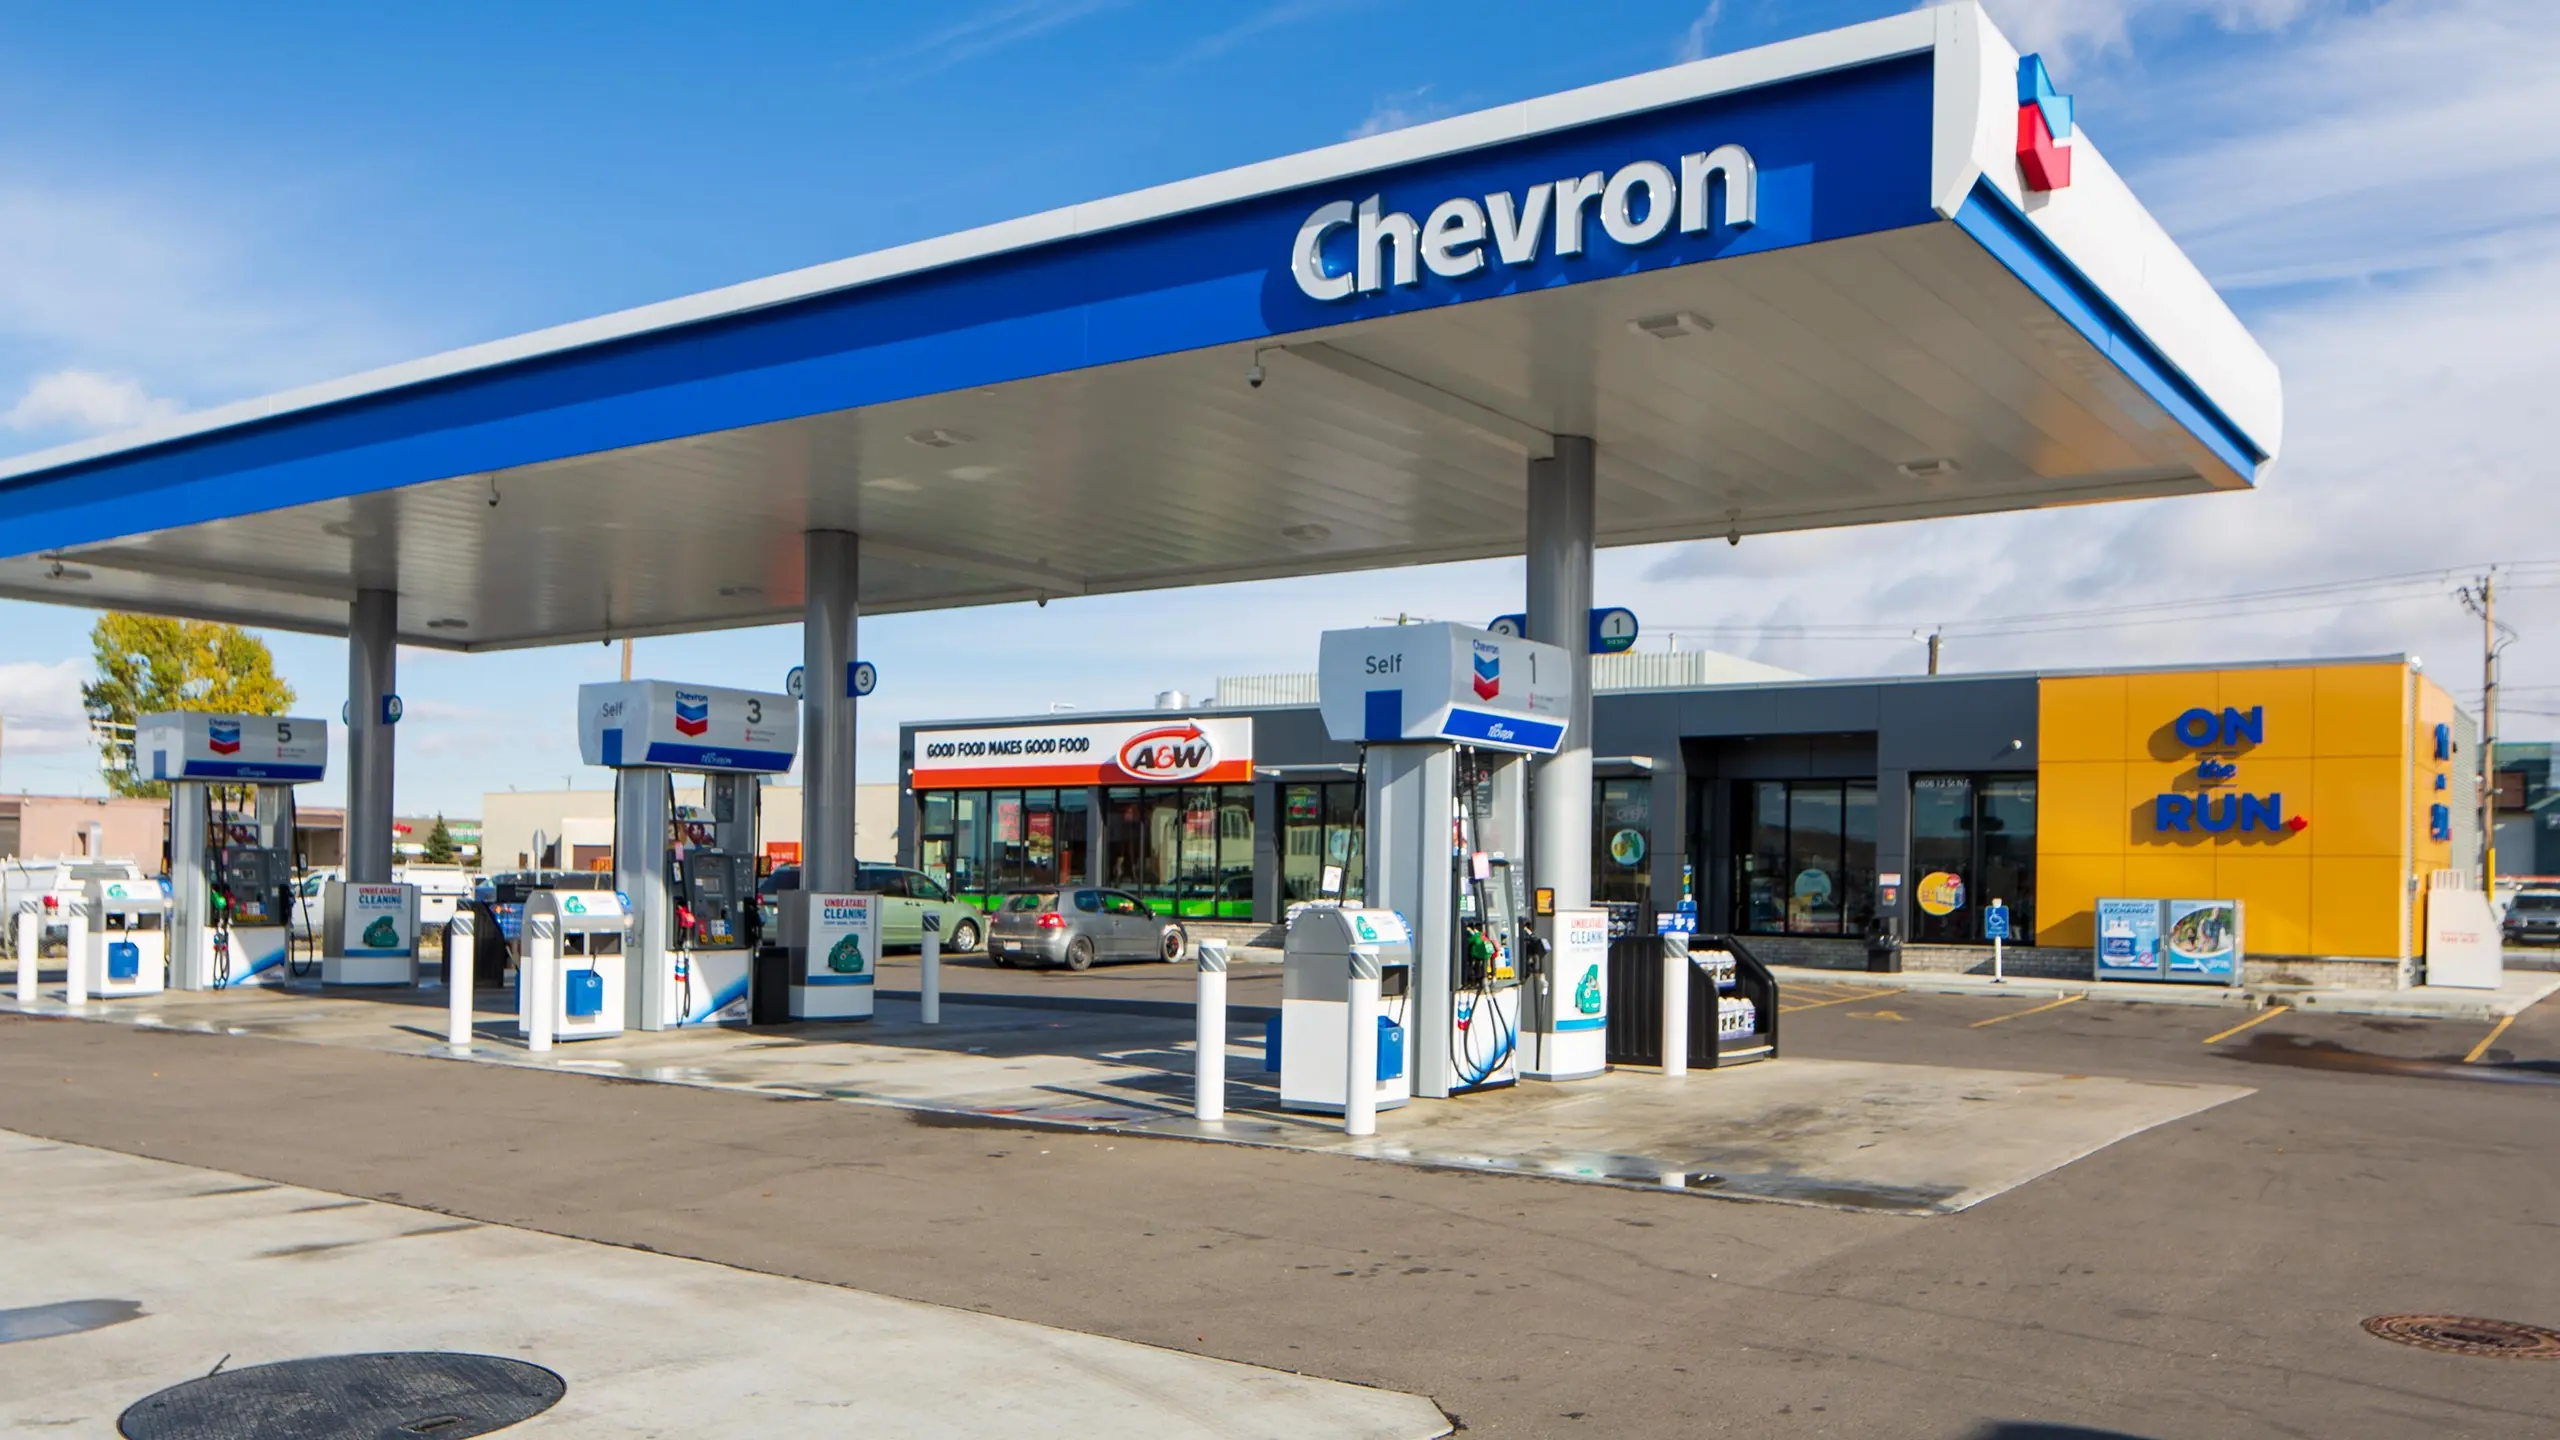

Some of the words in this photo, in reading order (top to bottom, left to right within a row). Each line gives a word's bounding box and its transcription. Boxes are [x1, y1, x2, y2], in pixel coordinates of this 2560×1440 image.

[1291, 143, 1757, 300] Chevron
[1613, 617, 1621, 635] 1
[1365, 653, 1403, 675] Self
[1529, 651, 1537, 684] 1
[792, 675, 802, 691] 4
[860, 671, 869, 687] 3
[675, 690, 709, 702] Chevron
[602, 702, 624, 718] Self
[746, 698, 762, 725] 3
[277, 723, 292, 743] 5
[2175, 705, 2263, 748] ON
[926, 743, 955, 758] GOOD
[958, 741, 986, 756] FOOD
[988, 740, 1022, 755] MAKES
[1025, 738, 1056, 753] GOOD
[1058, 737, 1090, 752] FOOD
[1133, 743, 1208, 770] A&W
[2196, 760, 2237, 779] the
[2156, 793, 2281, 833] RUN
[358, 895, 402, 904] CLEANING
[824, 898, 867, 908] UNBEATABLE
[824, 908, 867, 919] CLEANING
